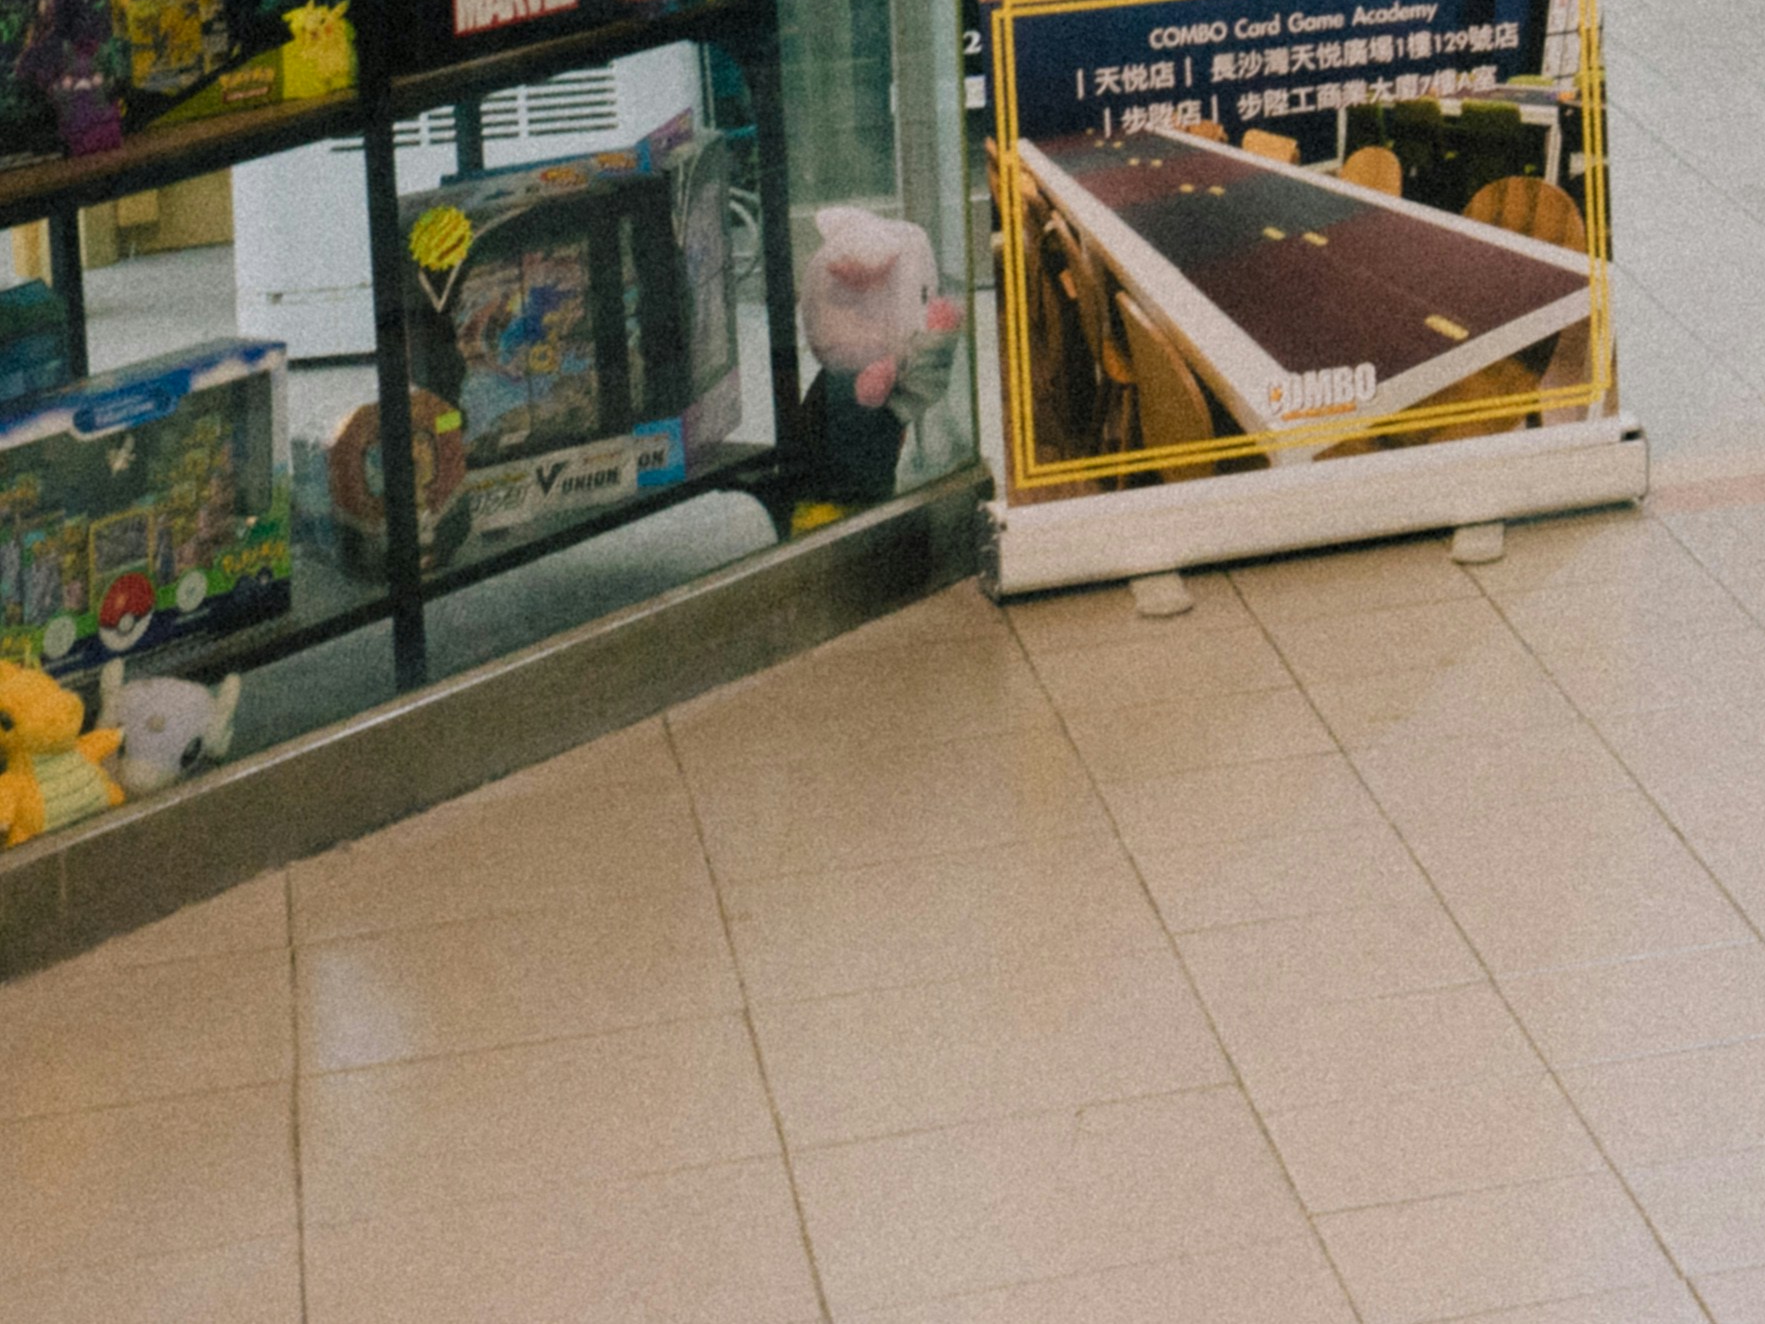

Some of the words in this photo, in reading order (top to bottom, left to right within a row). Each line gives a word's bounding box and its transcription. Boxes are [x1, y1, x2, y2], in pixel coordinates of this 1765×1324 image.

[1149, 20, 1228, 49] COMBO
[1234, 13, 1281, 39] Card
[1287, 11, 1345, 34] Game
[1351, 0, 1439, 28] Academy
